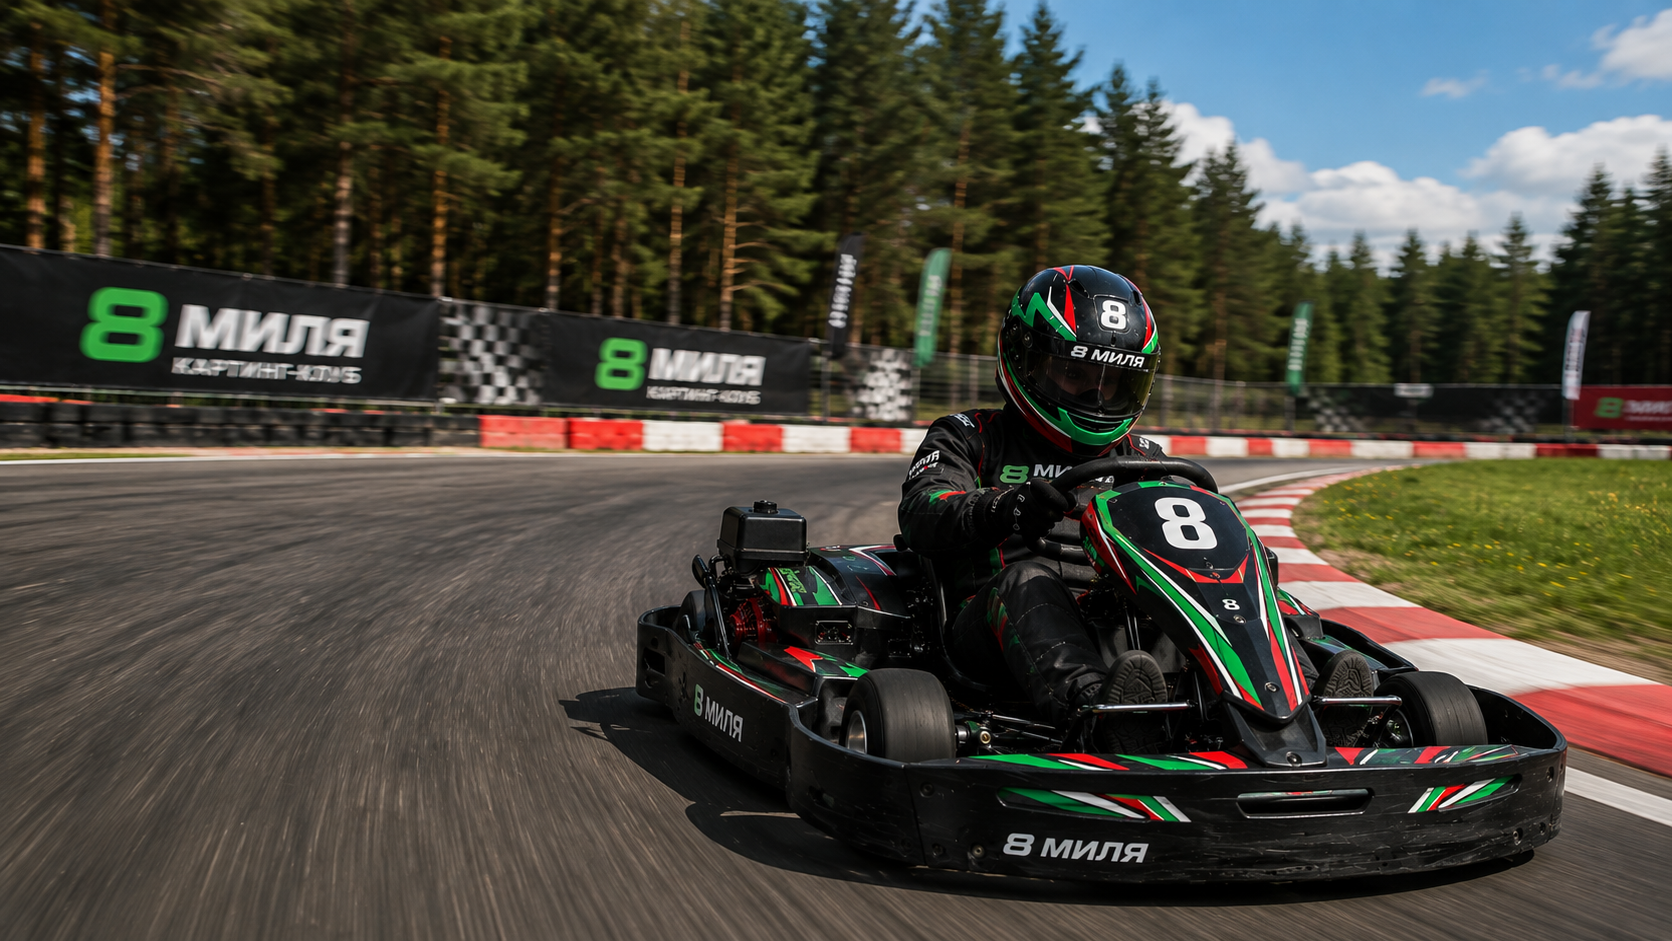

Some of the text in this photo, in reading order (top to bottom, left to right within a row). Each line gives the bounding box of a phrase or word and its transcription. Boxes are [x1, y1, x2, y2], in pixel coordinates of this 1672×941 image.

[80, 287, 370, 363] 8 МИЛЯ
[1101, 300, 1126, 330] 8
[595, 337, 766, 391] 8 МИЛЯ
[1070, 345, 1145, 368] 8 МИЛЯ
[1000, 465, 1029, 484] 8
[1154, 497, 1218, 550] 8
[1222, 598, 1241, 611] 8
[694, 683, 744, 743] 8 МИЛЯ
[1003, 833, 1150, 864] 8 МИЛЯ
